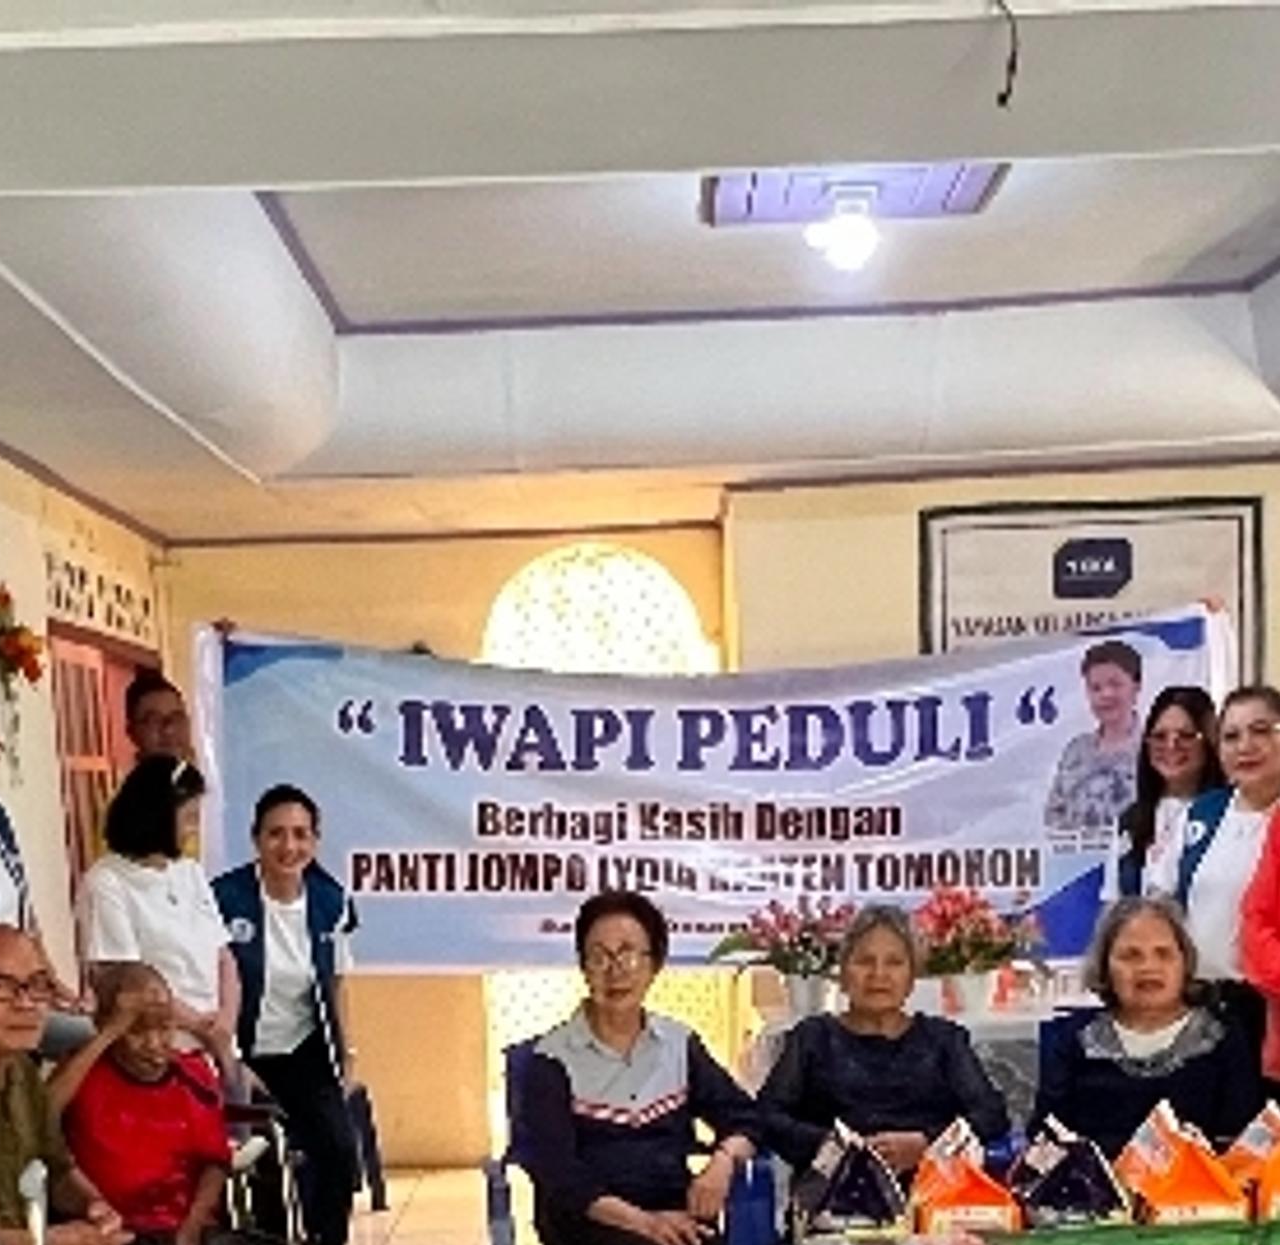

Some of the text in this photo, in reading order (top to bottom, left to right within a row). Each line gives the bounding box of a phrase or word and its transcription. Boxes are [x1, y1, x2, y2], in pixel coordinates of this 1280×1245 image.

[398, 699, 655, 771] IWAPI
[676, 691, 995, 771] PEDULI
[476, 801, 902, 845] Berbagi Kasih Dengan
[352, 853, 456, 892] PANTI
[464, 853, 587, 892] JOMPO
[854, 849, 1041, 892] TOMOHON
